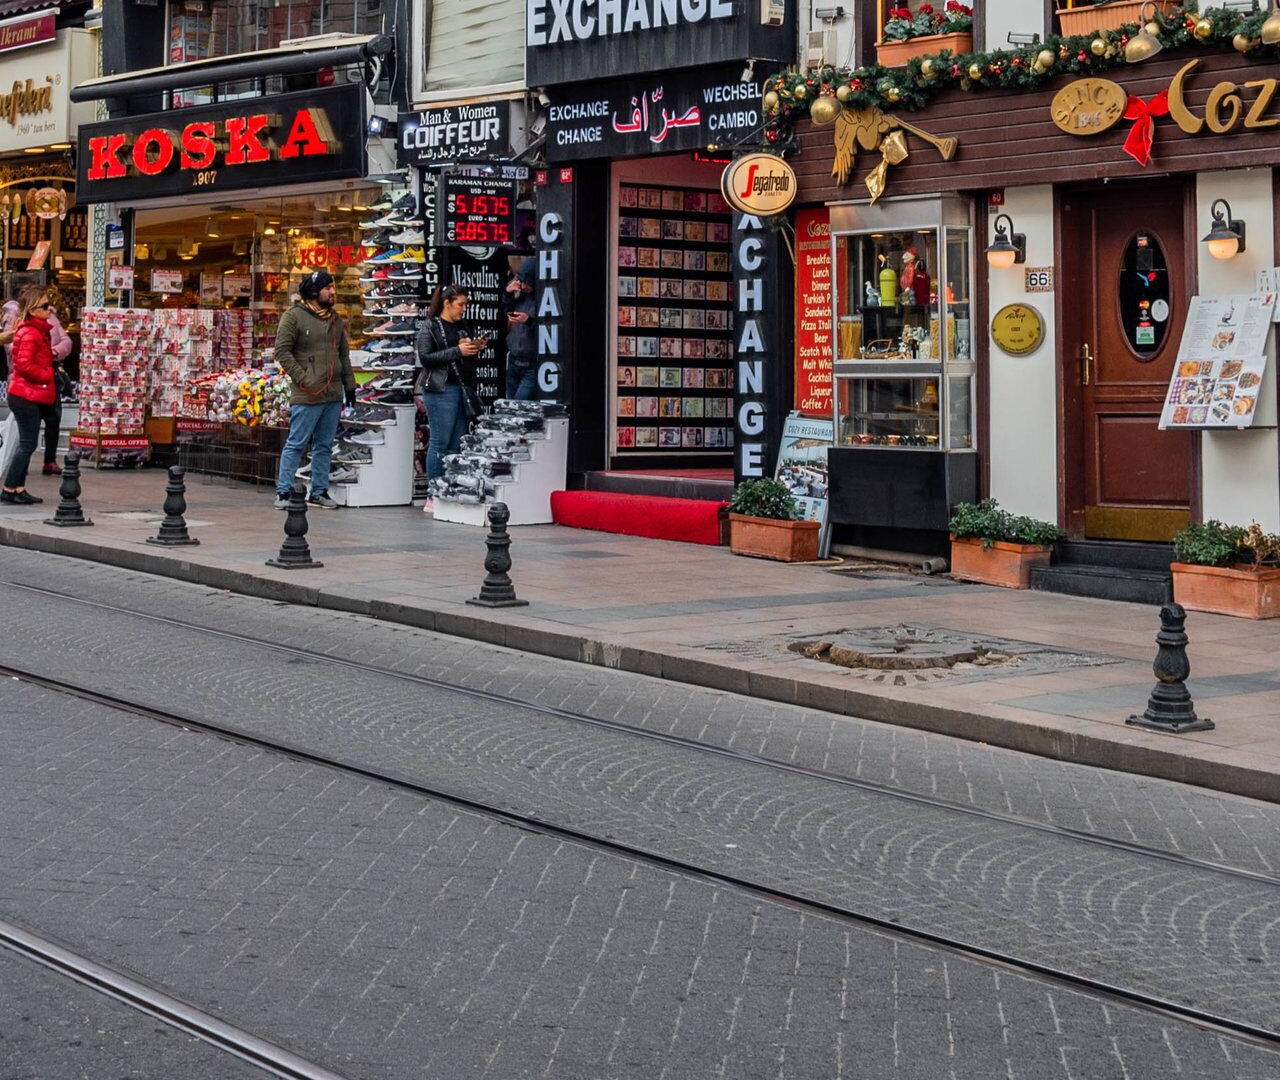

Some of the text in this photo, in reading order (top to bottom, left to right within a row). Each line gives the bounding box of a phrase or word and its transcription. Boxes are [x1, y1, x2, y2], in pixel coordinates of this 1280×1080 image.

[703, 82, 762, 104] WECHSEL
[420, 106, 497, 126] Man & Women
[549, 100, 610, 122] EXCHANGE
[708, 110, 758, 131] CAMBIO
[403, 117, 500, 149] COIFFEUR
[557, 126, 602, 145] CHANGE
[87, 107, 328, 181] KOSKA
[740, 164, 789, 199] Segafredo
[992, 193, 1001, 202] 60
[299, 245, 373, 268] KOSKA
[452, 264, 500, 289] Masculine
[812, 267, 829, 278] Lunch
[1029, 273, 1048, 286] 66
[811, 281, 831, 292] Dinner
[474, 291, 499, 302] Woman
[803, 293, 825, 305] Turkish
[538, 211, 560, 405] CHANG
[801, 320, 816, 330] Pizza
[814, 333, 828, 343] Beer
[800, 346, 819, 356] Scotch
[803, 359, 816, 369] Malt
[802, 399, 822, 409] Coffee
[177, 421, 201, 429] SPECIAL
[101, 438, 127, 446] SPECIAL
